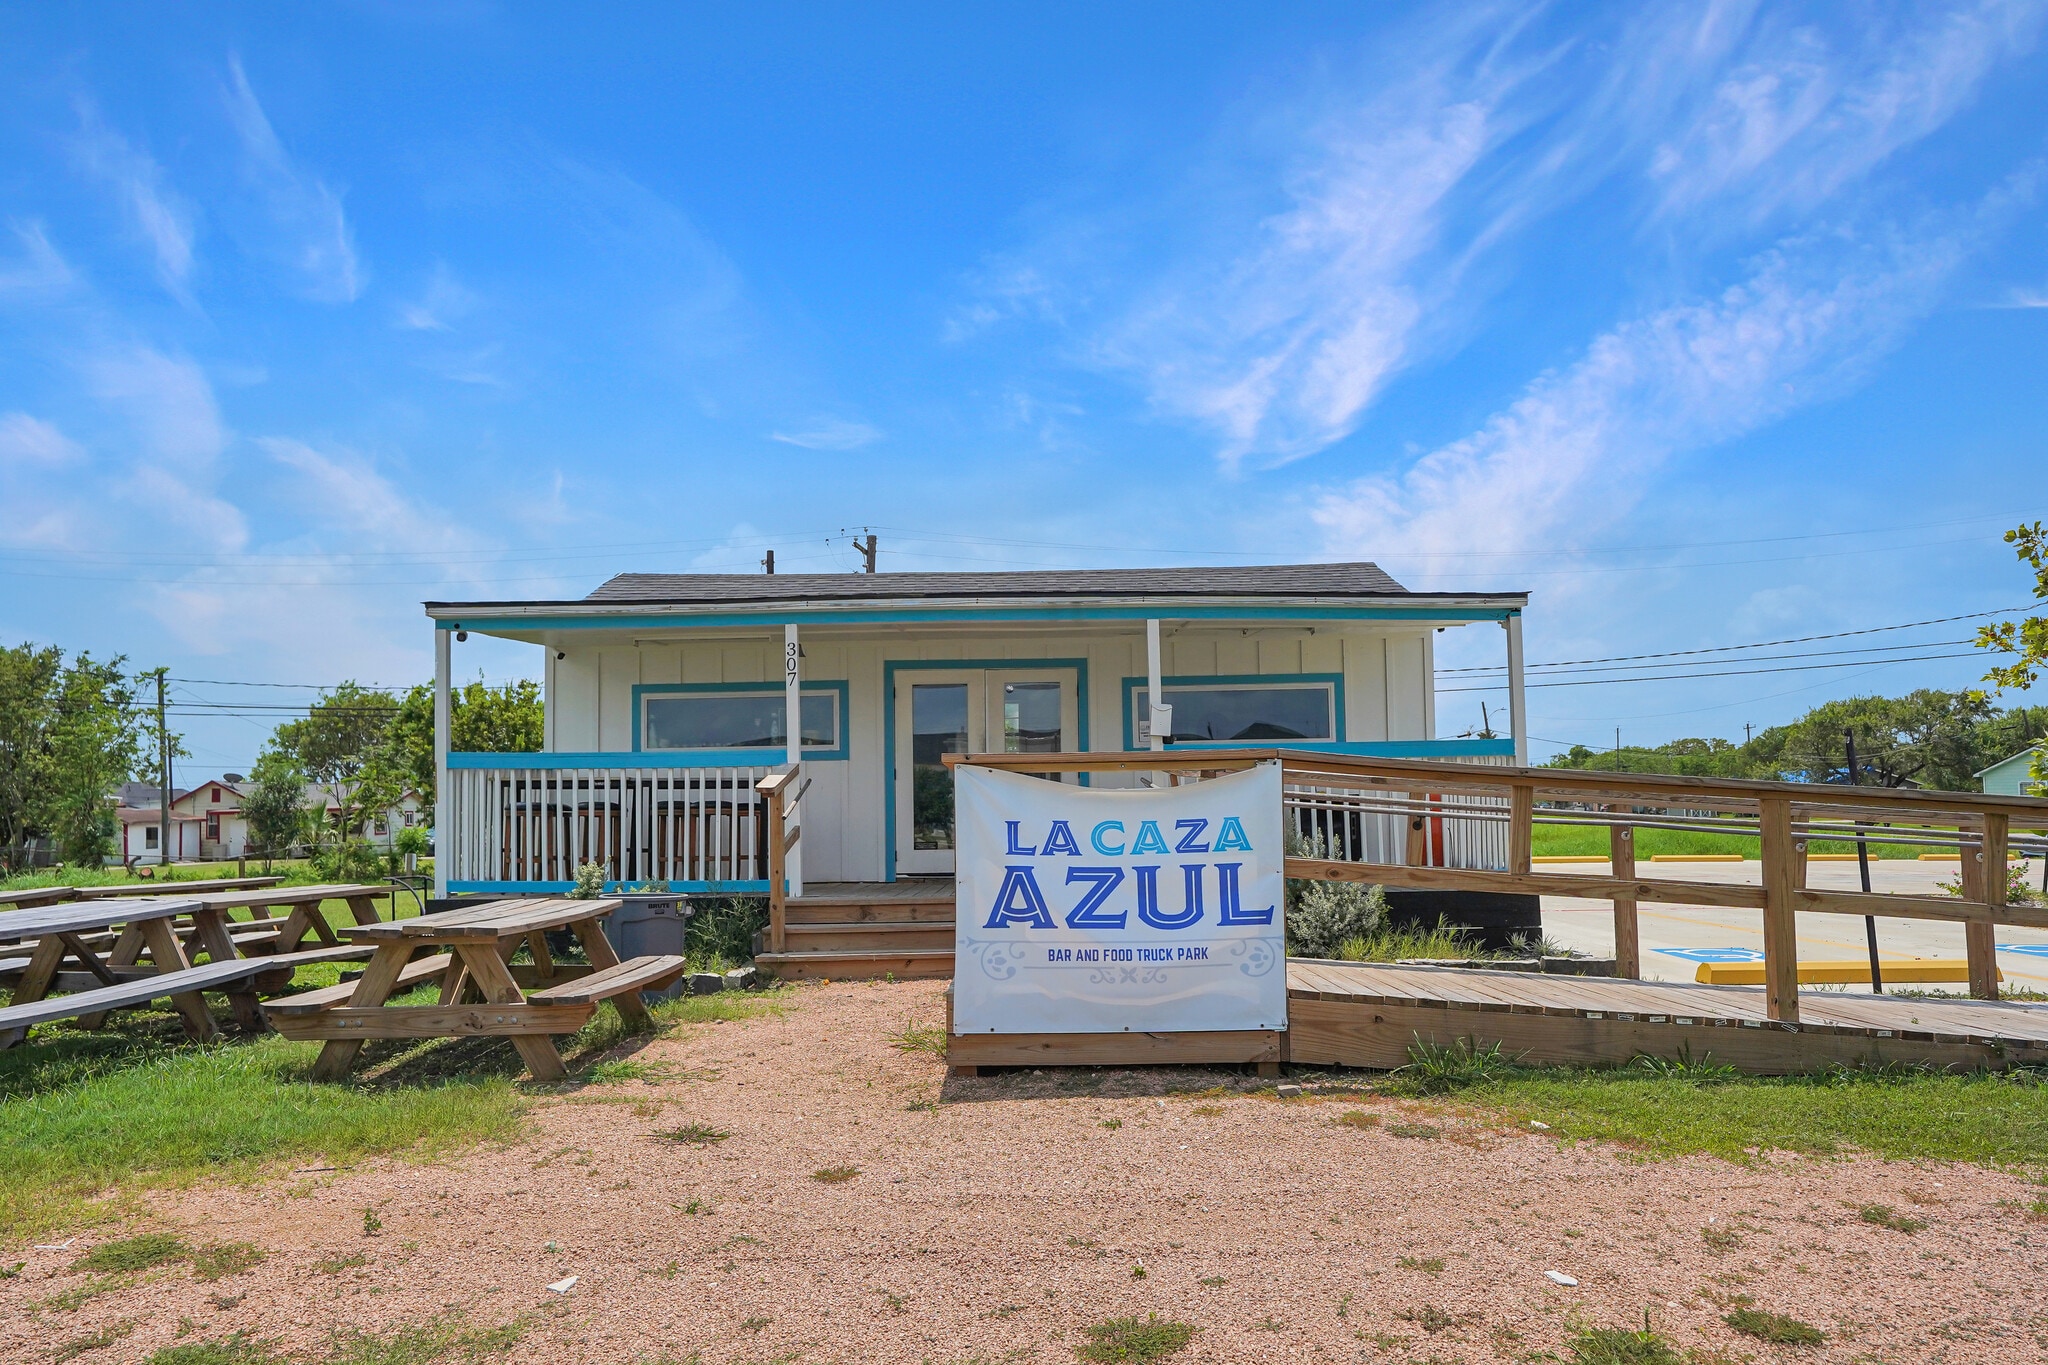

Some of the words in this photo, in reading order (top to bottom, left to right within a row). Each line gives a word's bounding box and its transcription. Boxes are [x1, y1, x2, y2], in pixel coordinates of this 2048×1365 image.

[786, 642, 797, 686] 307
[1005, 820, 1082, 856] LA
[1090, 816, 1253, 856] CAZA
[982, 862, 1275, 930] AZUL
[1048, 949, 1072, 962] BAR
[1075, 949, 1099, 962] AND
[1103, 949, 1133, 962] FOOD
[1136, 948, 1174, 961] TRUCK
[1177, 947, 1209, 960] PARK
